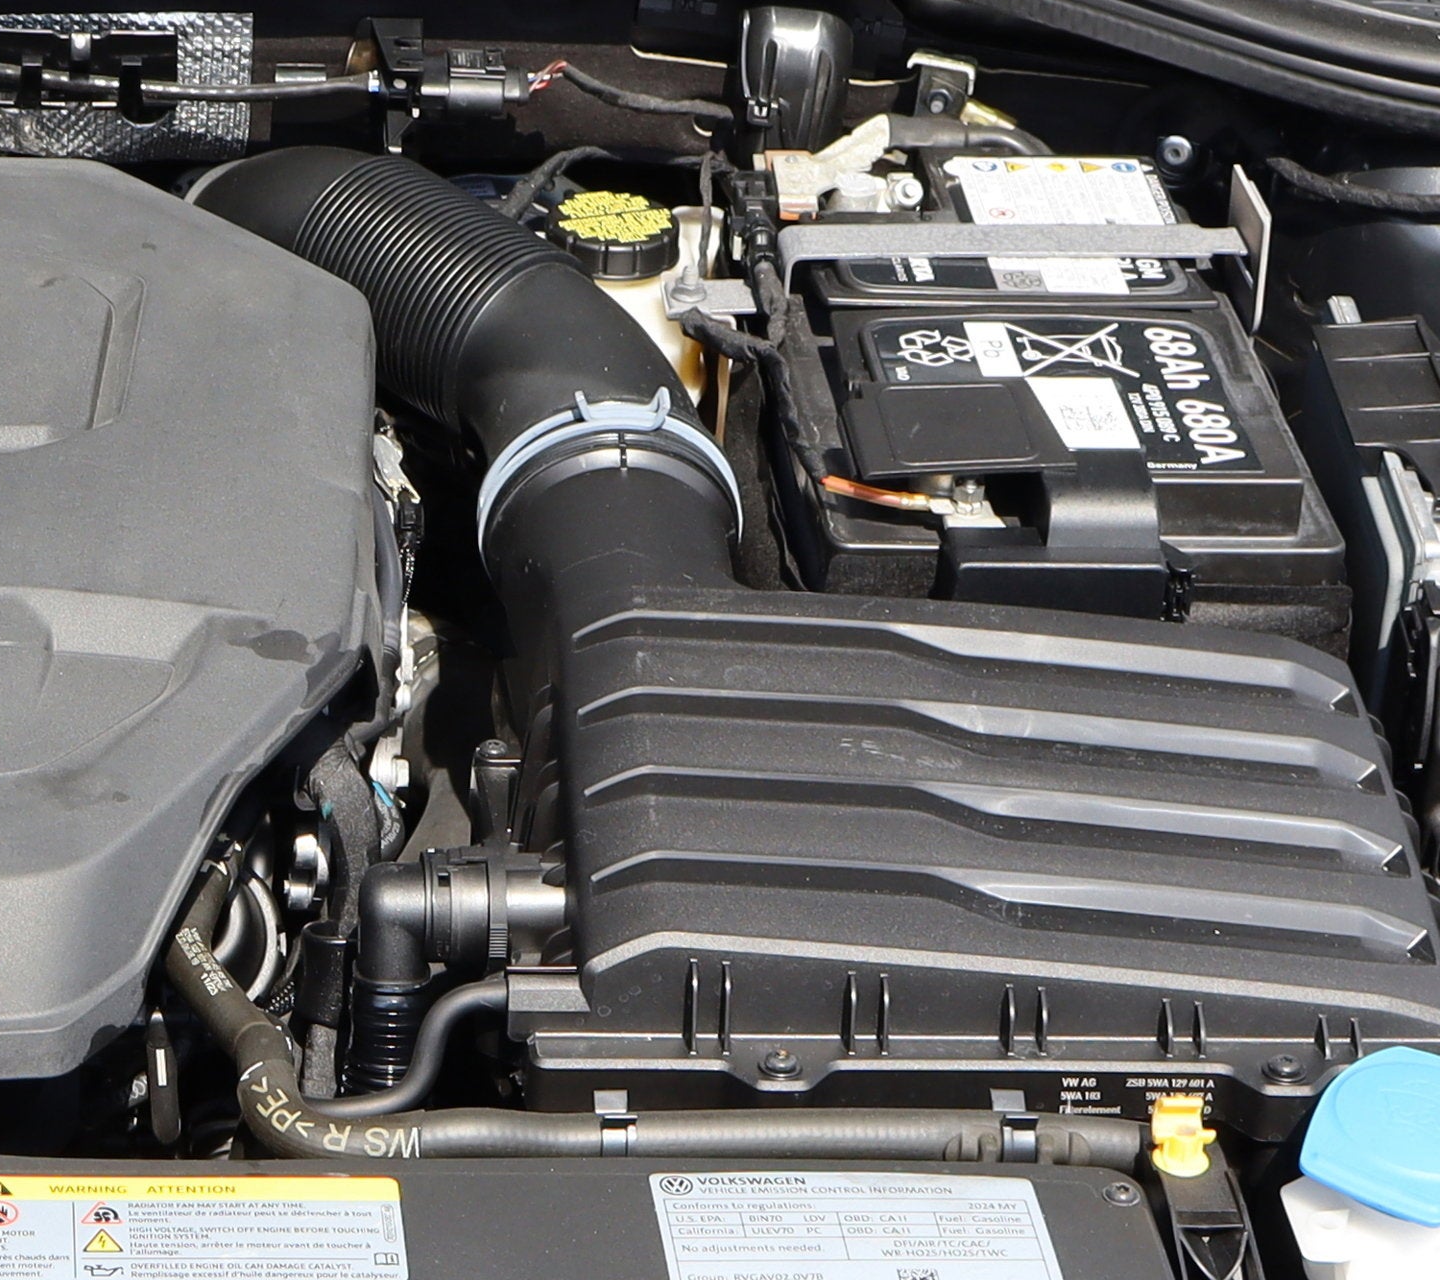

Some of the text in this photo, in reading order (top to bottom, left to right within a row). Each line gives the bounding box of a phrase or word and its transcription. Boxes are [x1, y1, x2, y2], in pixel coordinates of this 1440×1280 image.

[1143, 327, 1246, 464] 68Ah 680A
[1163, 434, 1181, 443] C
[1147, 462, 1198, 470] Germany
[1062, 1078, 1097, 1088] VW AG
[1125, 1078, 1145, 1087] ZSB
[1147, 1078, 1169, 1088] 5WA
[1172, 1079, 1188, 1088] 129
[1207, 1079, 1215, 1088] A
[1060, 1092, 1082, 1101] 5WA
[322, 1122, 351, 1152] R
[697, 1177, 806, 1185] VOLKSWAGEN
[50, 1185, 236, 1194] WARNING ATTENTION
[672, 1202, 816, 1211] Conforms to regulations:
[968, 1202, 1017, 1210] 2024 MY
[939, 1215, 1021, 1223] Fuel: Gasoline
[678, 1227, 738, 1235] California:
[751, 1227, 822, 1235] ULEV70 PC
[942, 1227, 1025, 1235] Fuel: Gasoline
[681, 1245, 824, 1254] No adjustments needed.
[131, 1271, 190, 1279] Remplissage
